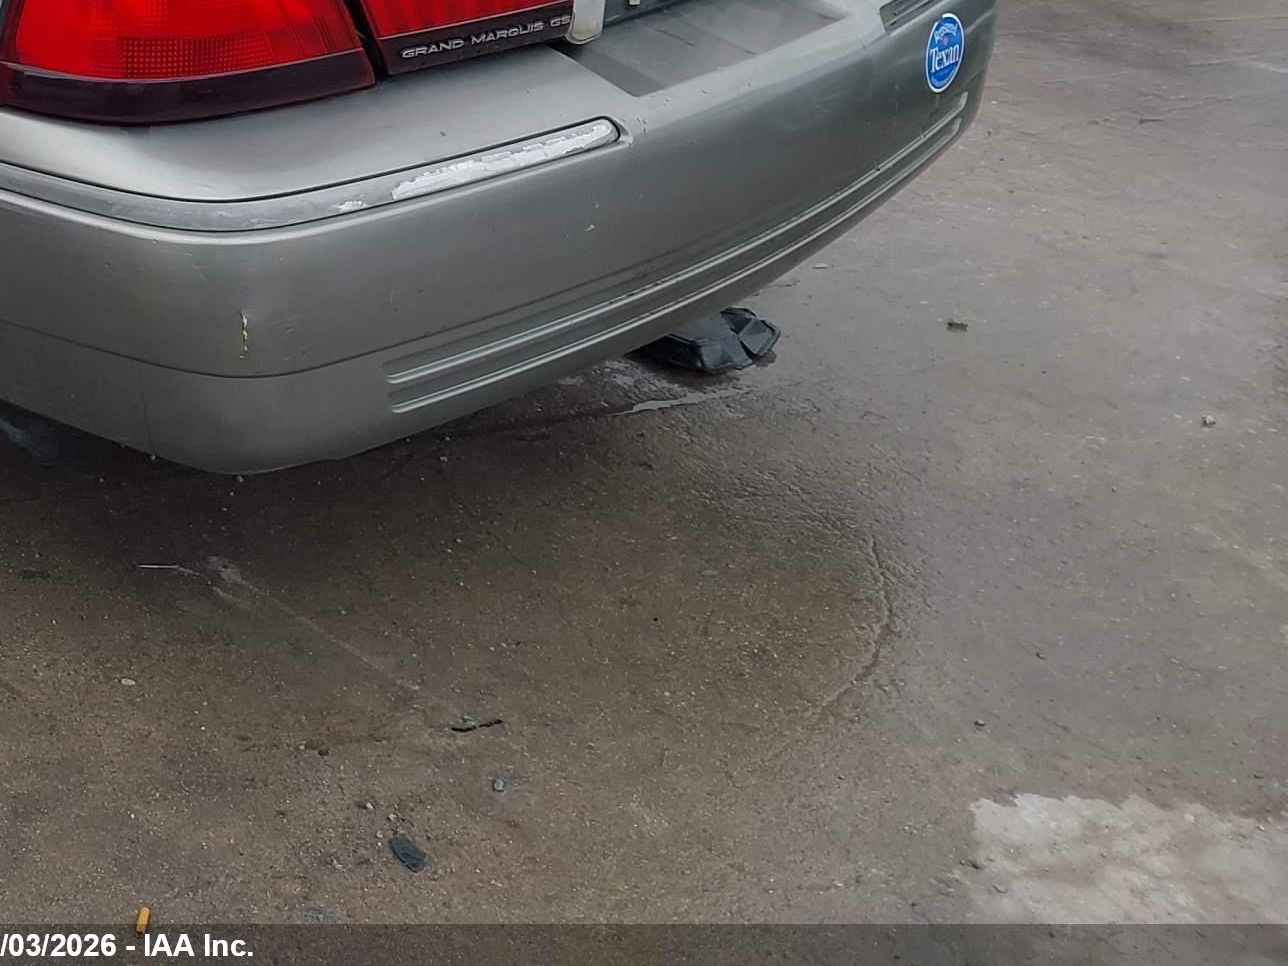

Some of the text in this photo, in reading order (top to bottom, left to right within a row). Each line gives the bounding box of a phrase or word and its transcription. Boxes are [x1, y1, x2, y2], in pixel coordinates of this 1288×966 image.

[402, 38, 464, 59] GRAND
[471, 21, 544, 46] MARQUIS
[930, 44, 960, 73] Texan
